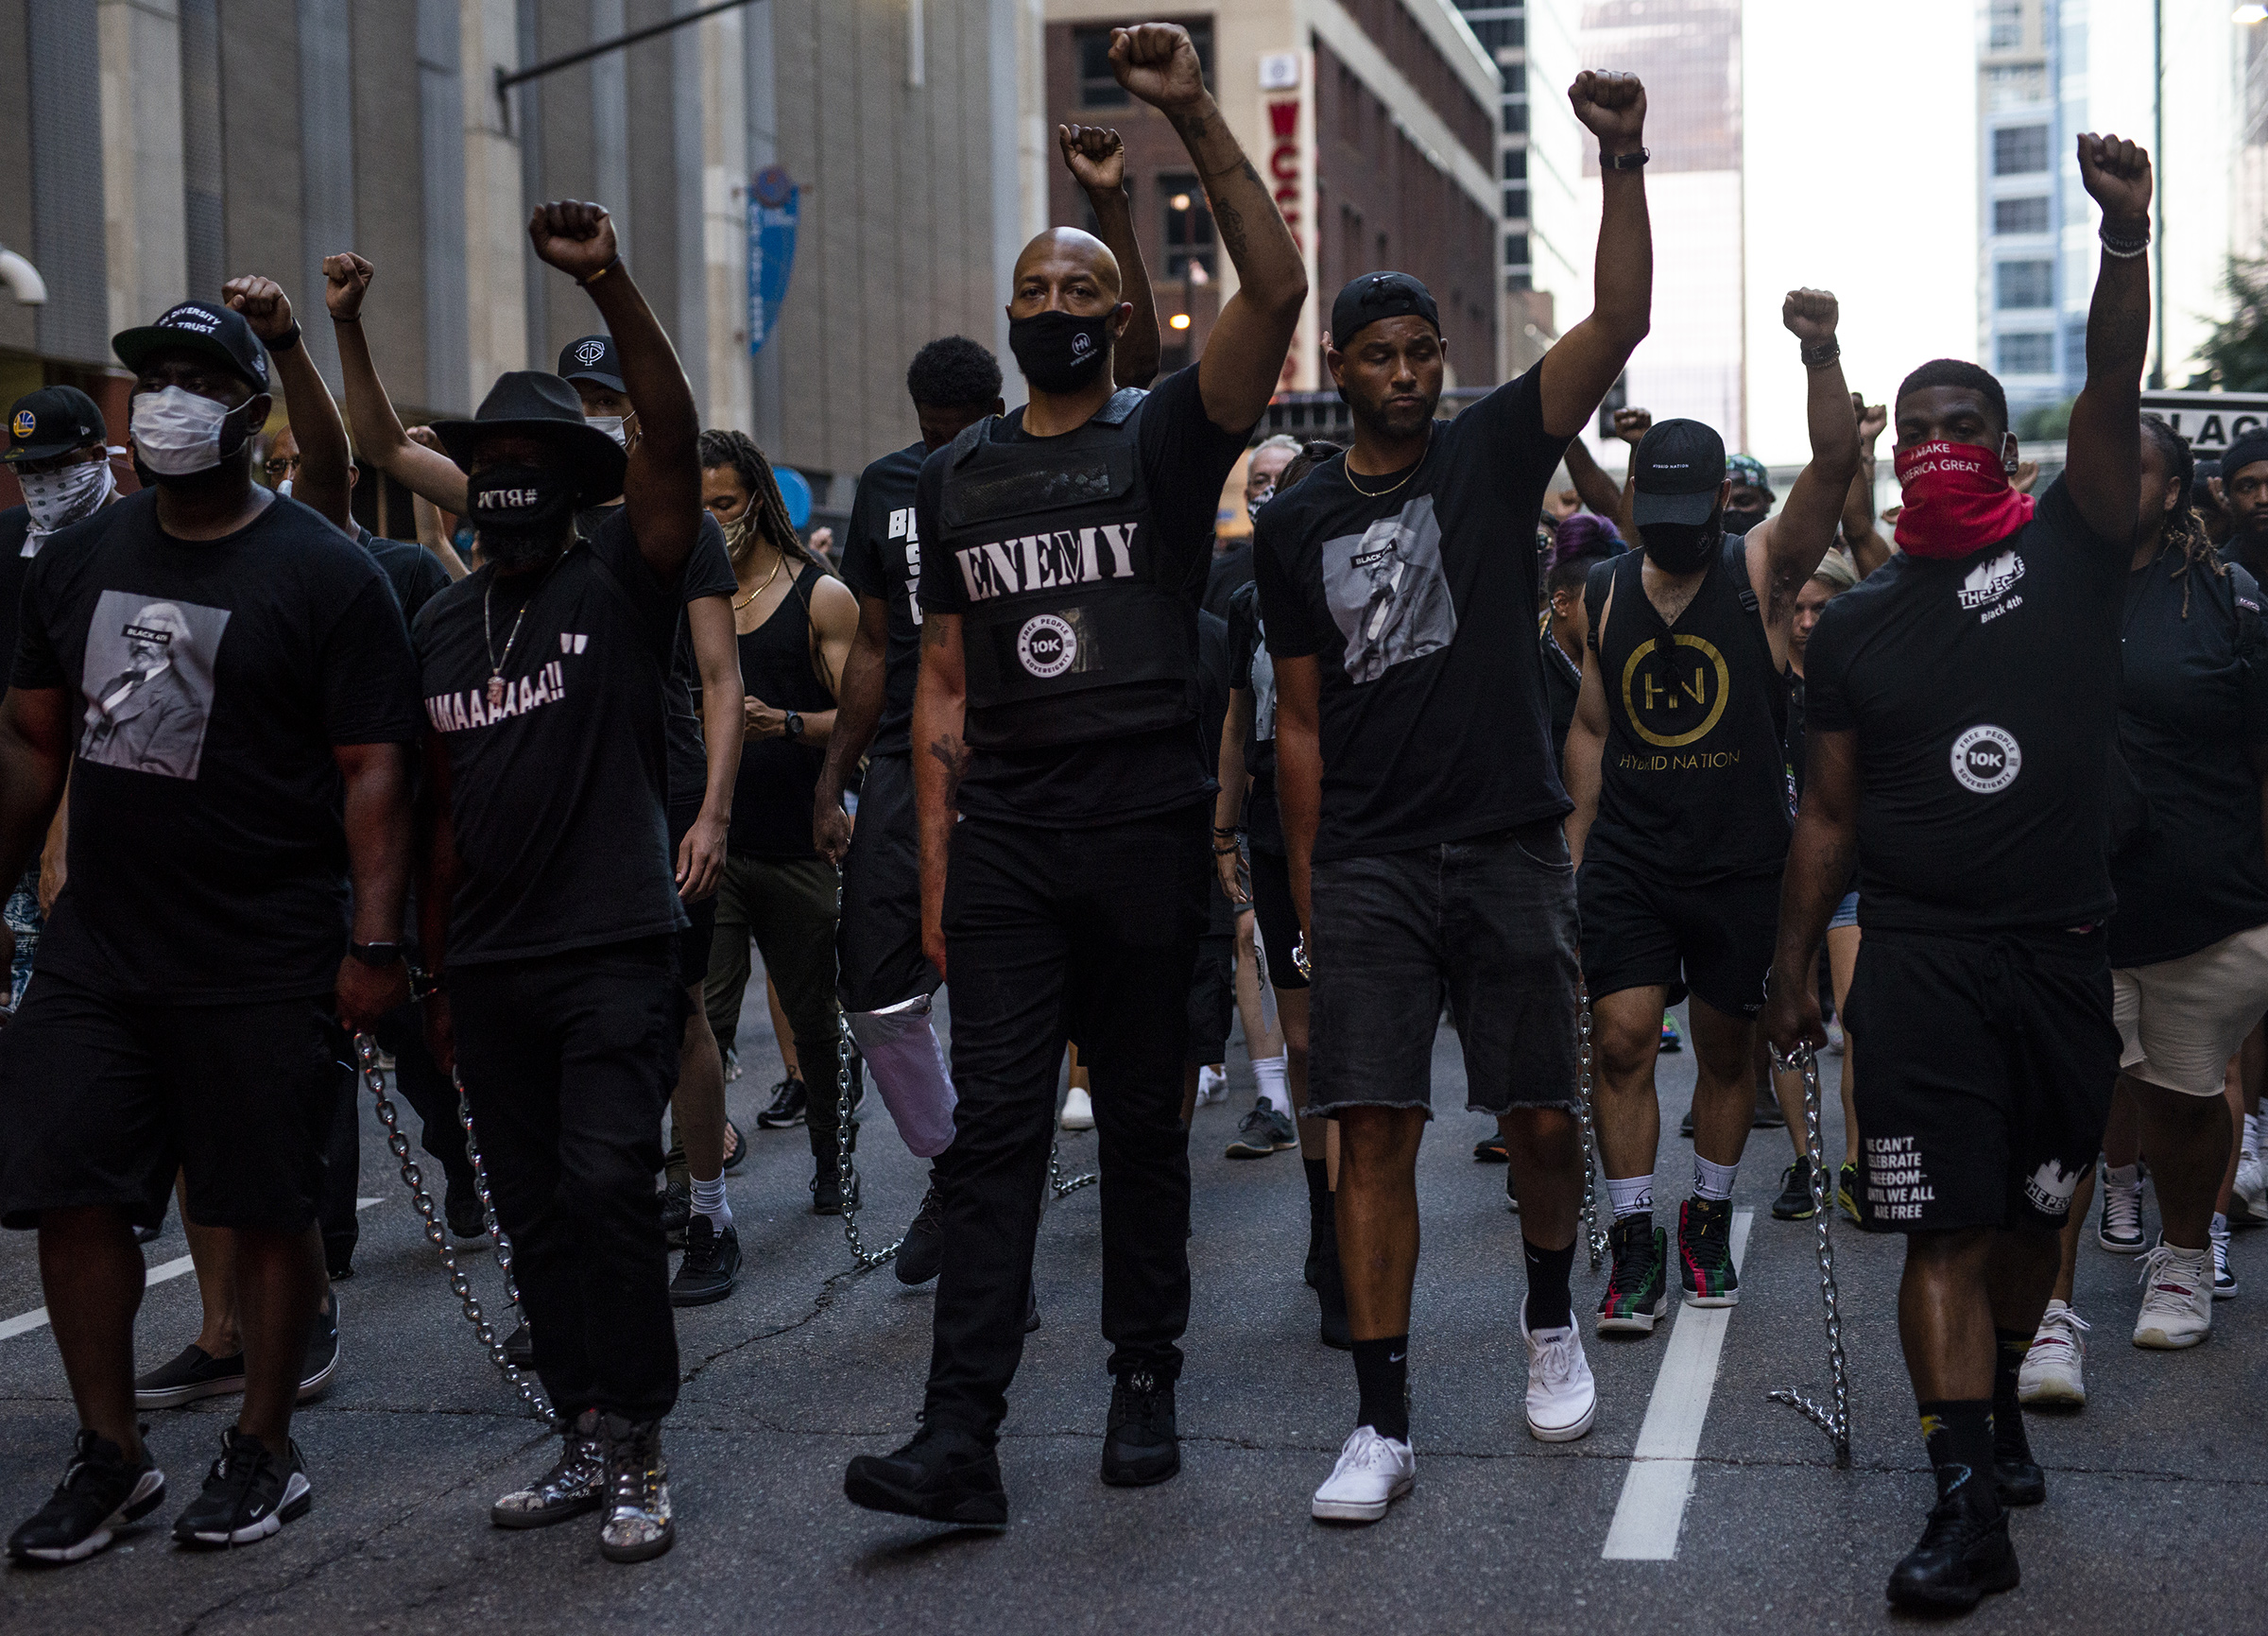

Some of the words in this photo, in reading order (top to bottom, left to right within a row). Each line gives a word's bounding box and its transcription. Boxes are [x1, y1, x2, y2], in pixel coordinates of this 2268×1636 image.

[170, 306, 222, 326] DIVERSITY
[177, 321, 216, 335] TRUST
[2140, 413, 2268, 444] LAC
[1916, 443, 1951, 458] MAKE
[1939, 458, 1982, 474] GREAT
[954, 523, 1139, 602] ENEMY
[1355, 553, 1382, 565] BLACK
[1981, 603, 2006, 624] Black
[2005, 594, 2023, 611] 4th
[1022, 622, 1037, 641] FREE
[1040, 618, 1069, 635] PEOPLE
[1031, 638, 1061, 654] 10K
[1025, 653, 1070, 673] SOVEREIGNTY
[1959, 731, 1981, 749] FREE
[1985, 730, 2016, 752] PEOPLE
[1619, 753, 1667, 770] HYBRID
[1673, 749, 1741, 770] NATION
[1969, 751, 2002, 767] 10K
[1958, 767, 2011, 789] SOVEREIGNTY
[1876, 1136, 1915, 1152] CAN'T
[1886, 1187, 1909, 1203] WE
[1909, 1185, 1936, 1201] ALL
[2025, 1178, 2048, 1203] THE
[1891, 1203, 1923, 1219] FREE
